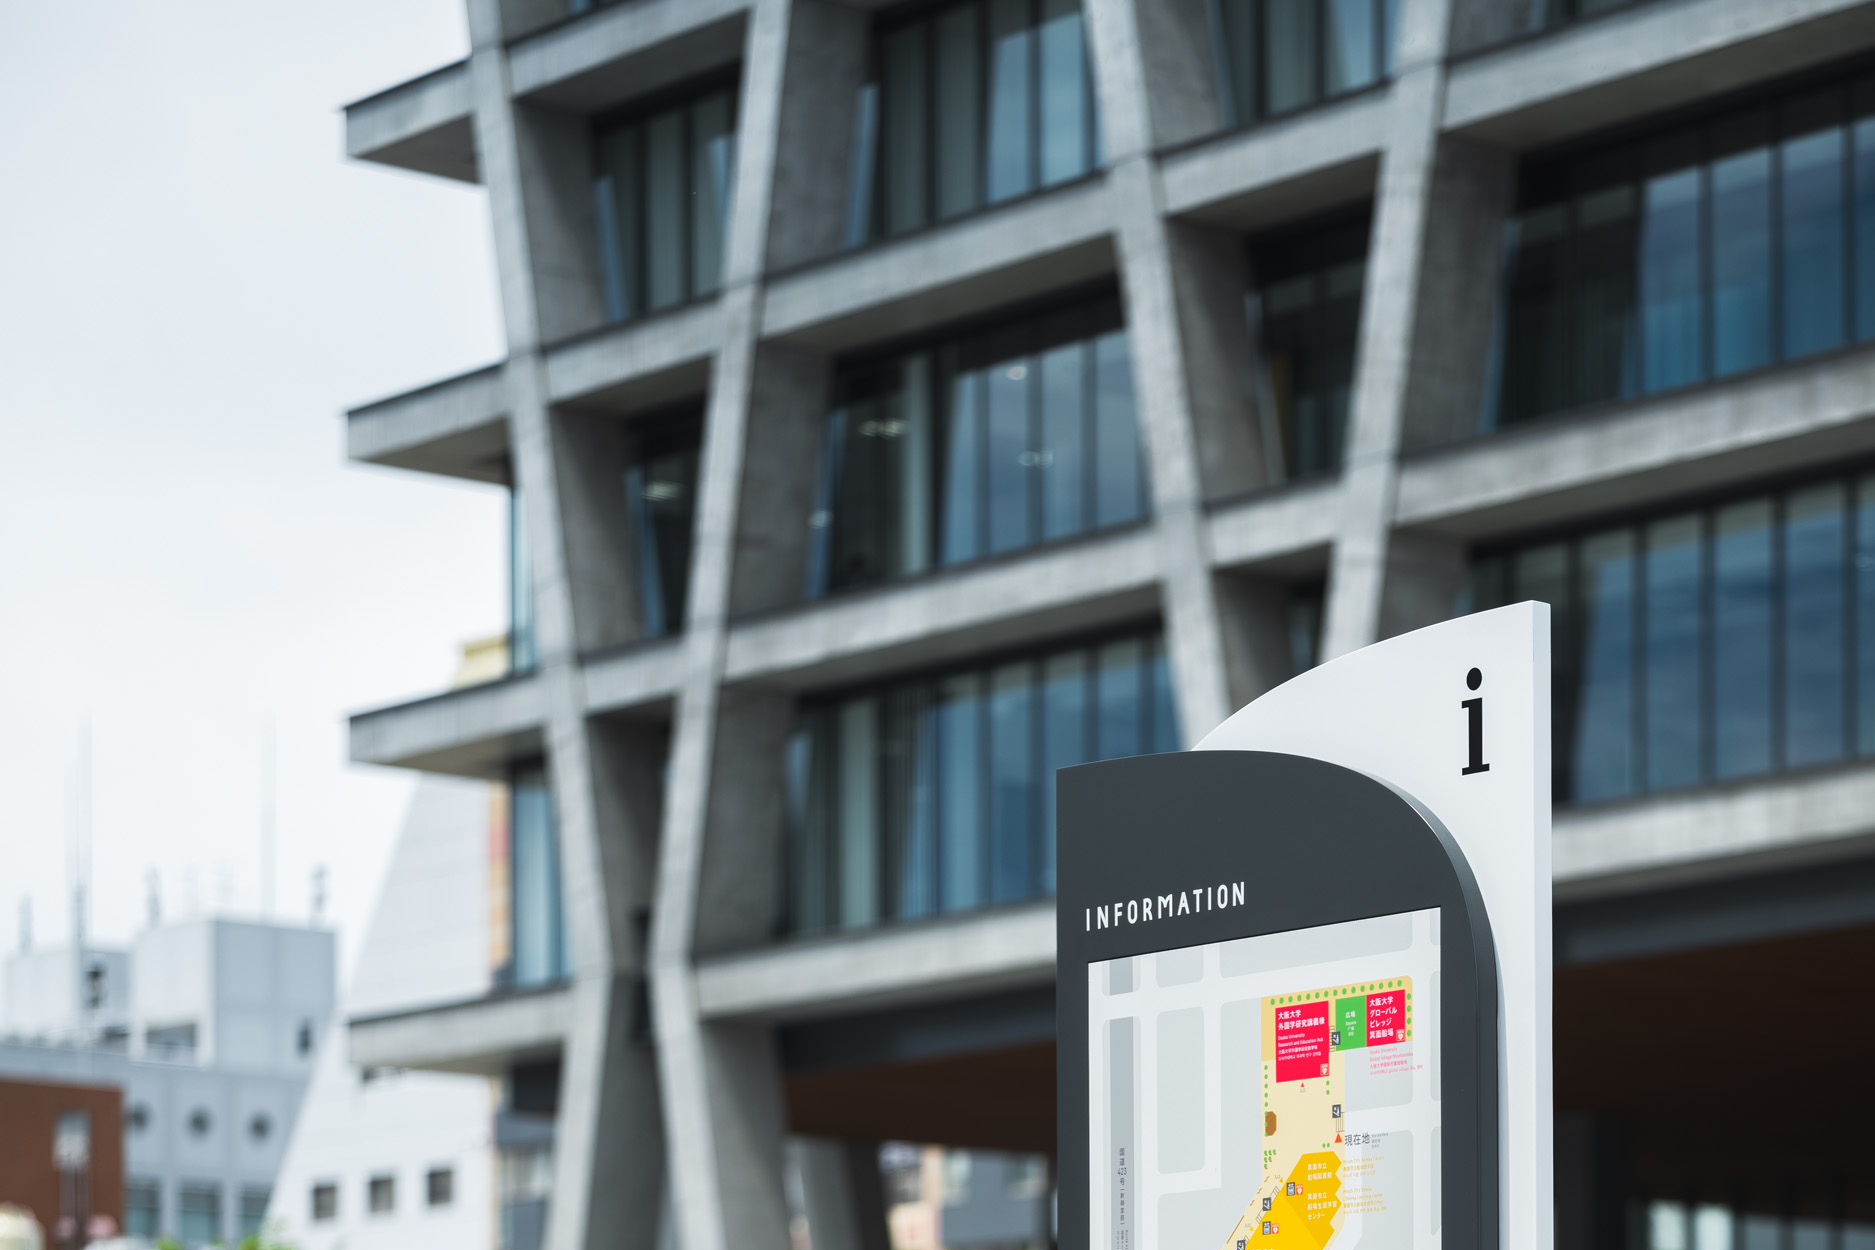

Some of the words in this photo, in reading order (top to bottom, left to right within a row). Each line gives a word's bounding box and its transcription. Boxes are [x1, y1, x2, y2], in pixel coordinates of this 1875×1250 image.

[1461, 667, 1490, 776] i
[1085, 881, 1245, 932] INFORMATION
[1369, 996, 1394, 1007] 大阪大学
[1278, 1009, 1302, 1020] 大阪大学
[1369, 1007, 1398, 1018] グローバル
[1369, 1018, 1392, 1028] ビレッジ
[1344, 1132, 1370, 1146] 現在地
